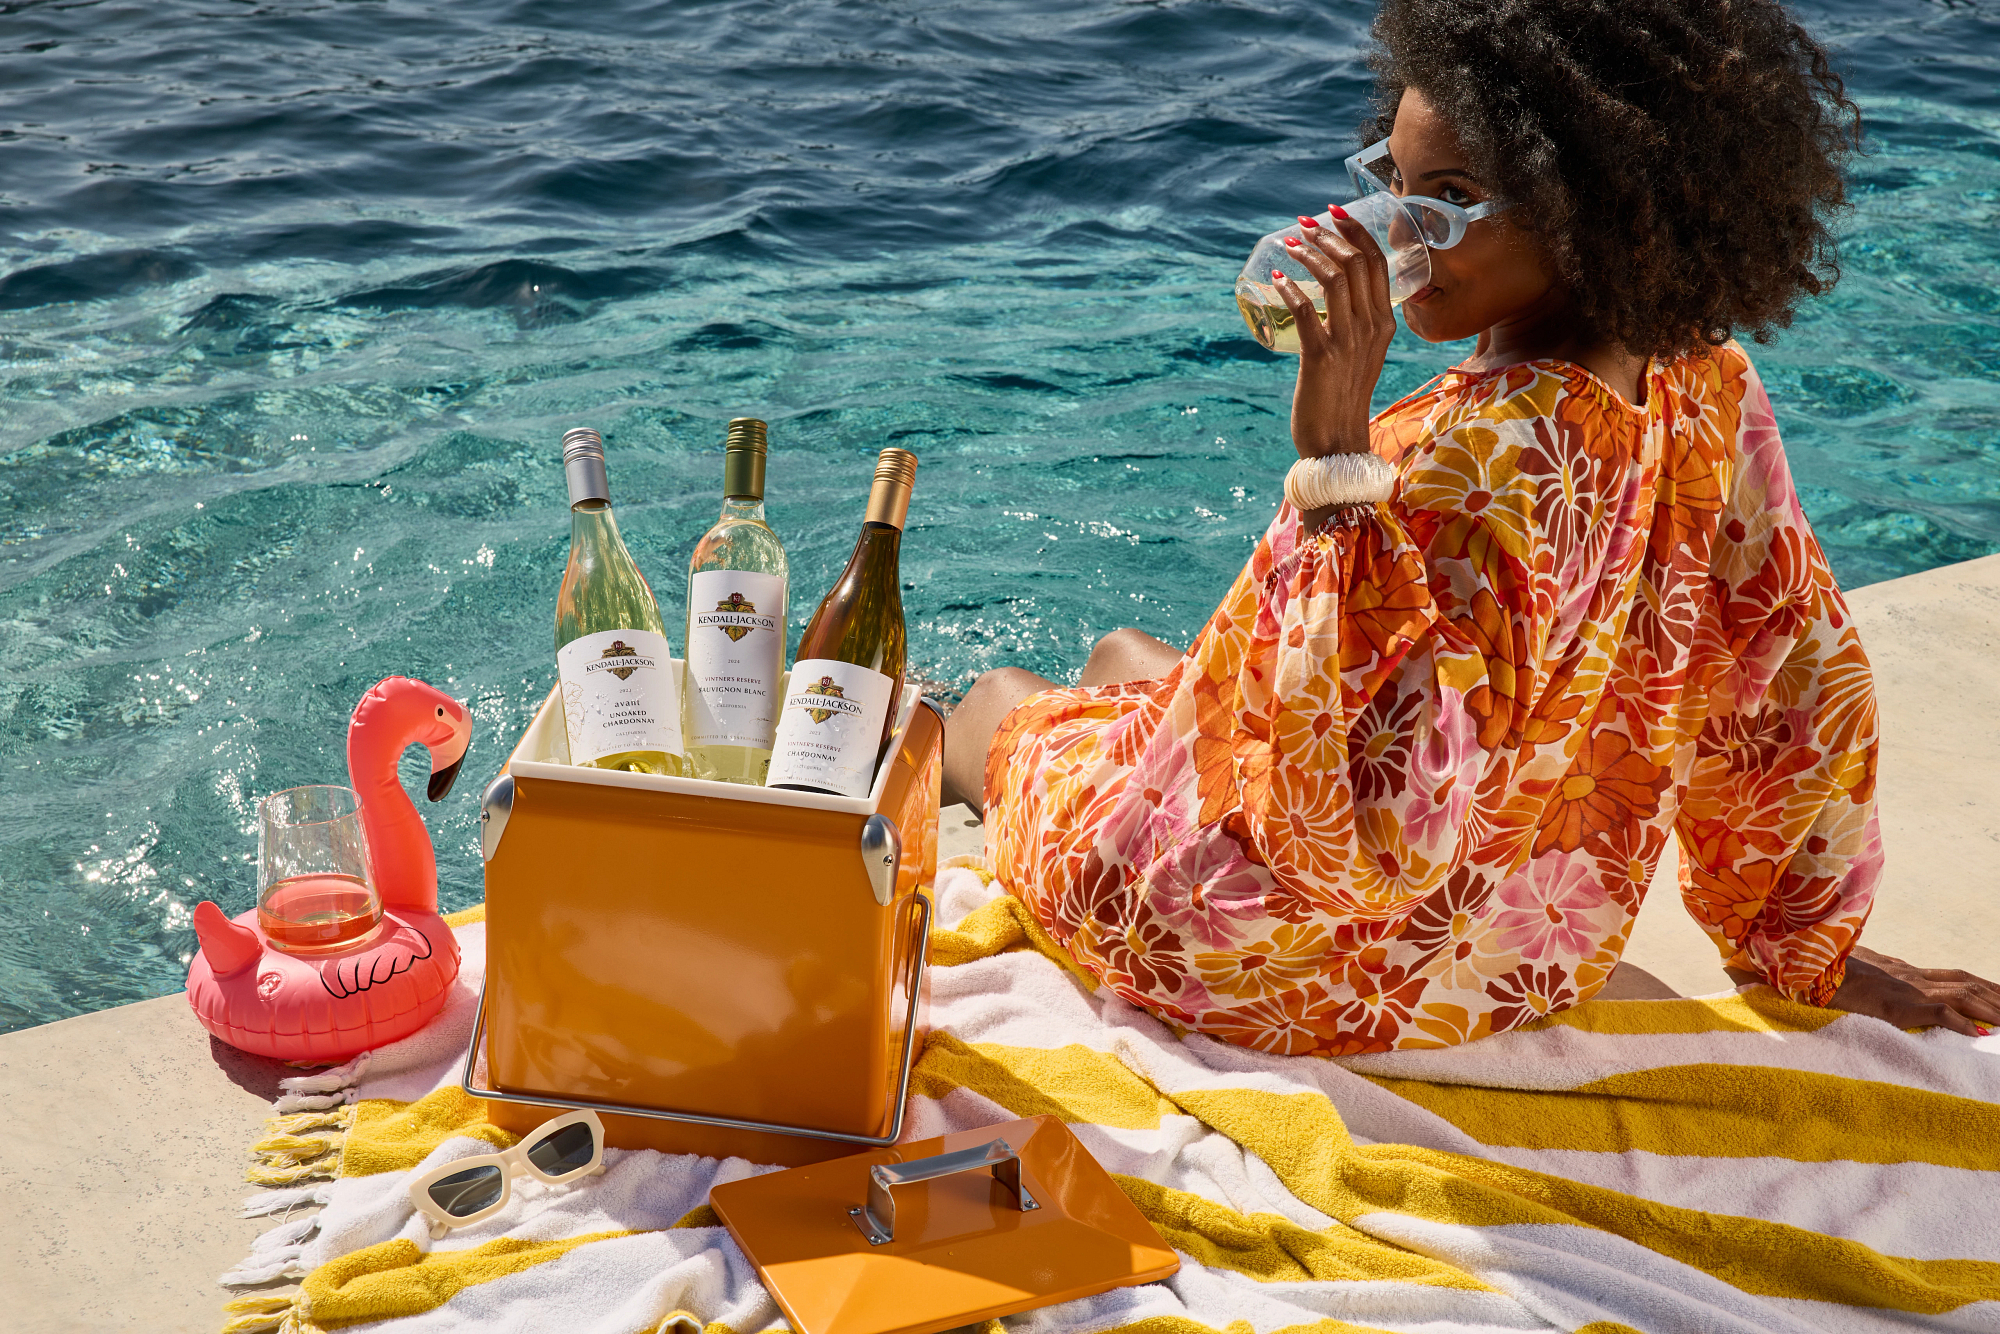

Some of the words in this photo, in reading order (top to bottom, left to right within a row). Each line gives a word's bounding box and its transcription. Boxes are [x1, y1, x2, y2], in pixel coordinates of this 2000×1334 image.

[698, 615, 774, 628] KENDALL-JACKSON
[586, 658, 655, 672] KENDALL-JACKSON
[744, 688, 766, 696] BLANC
[614, 700, 640, 708] avant
[790, 697, 864, 714] KENDALL-JACKSON
[609, 710, 647, 719] UNOAKED
[602, 718, 655, 728] CHARDONNAY
[816, 743, 842, 753] RESERVE
[787, 750, 837, 762] CHARDONNAY
